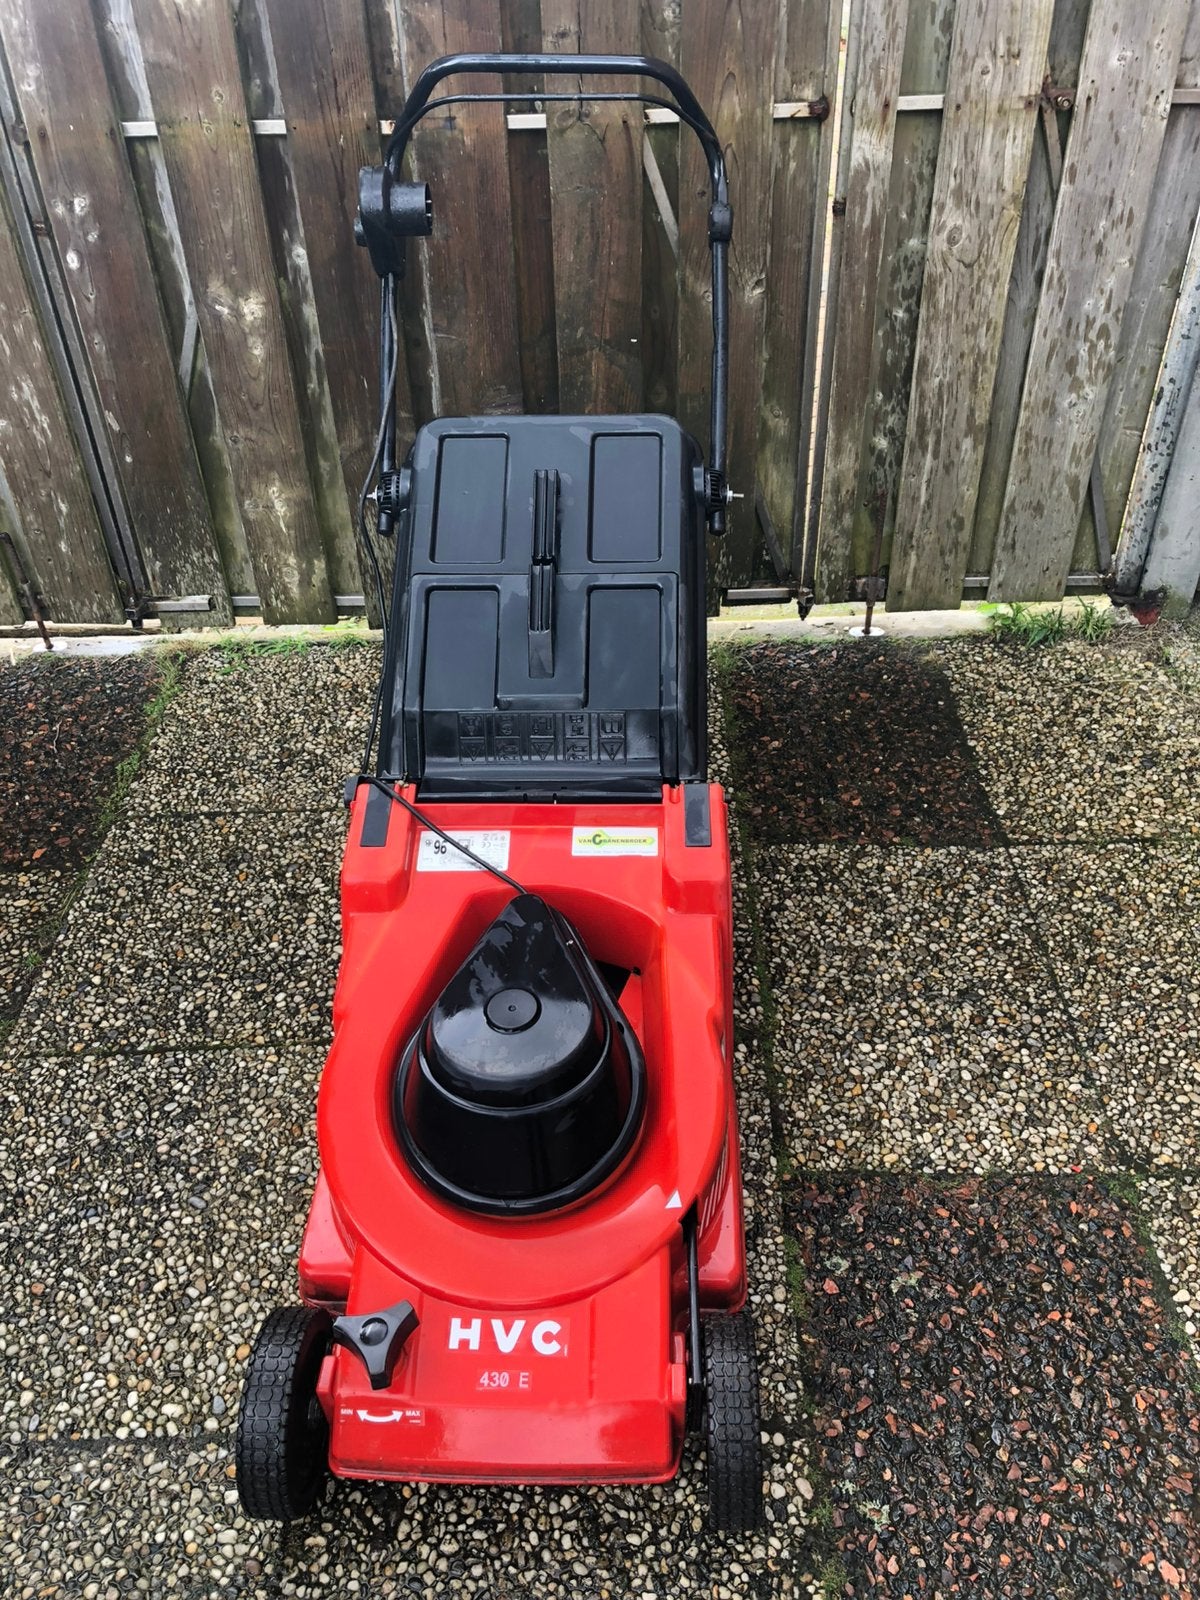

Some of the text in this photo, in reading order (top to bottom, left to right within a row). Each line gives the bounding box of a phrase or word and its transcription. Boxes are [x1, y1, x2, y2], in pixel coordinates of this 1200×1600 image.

[448, 1317, 562, 1355] HVC
[479, 1371, 529, 1388] 430 E
[340, 1408, 354, 1416] MIN
